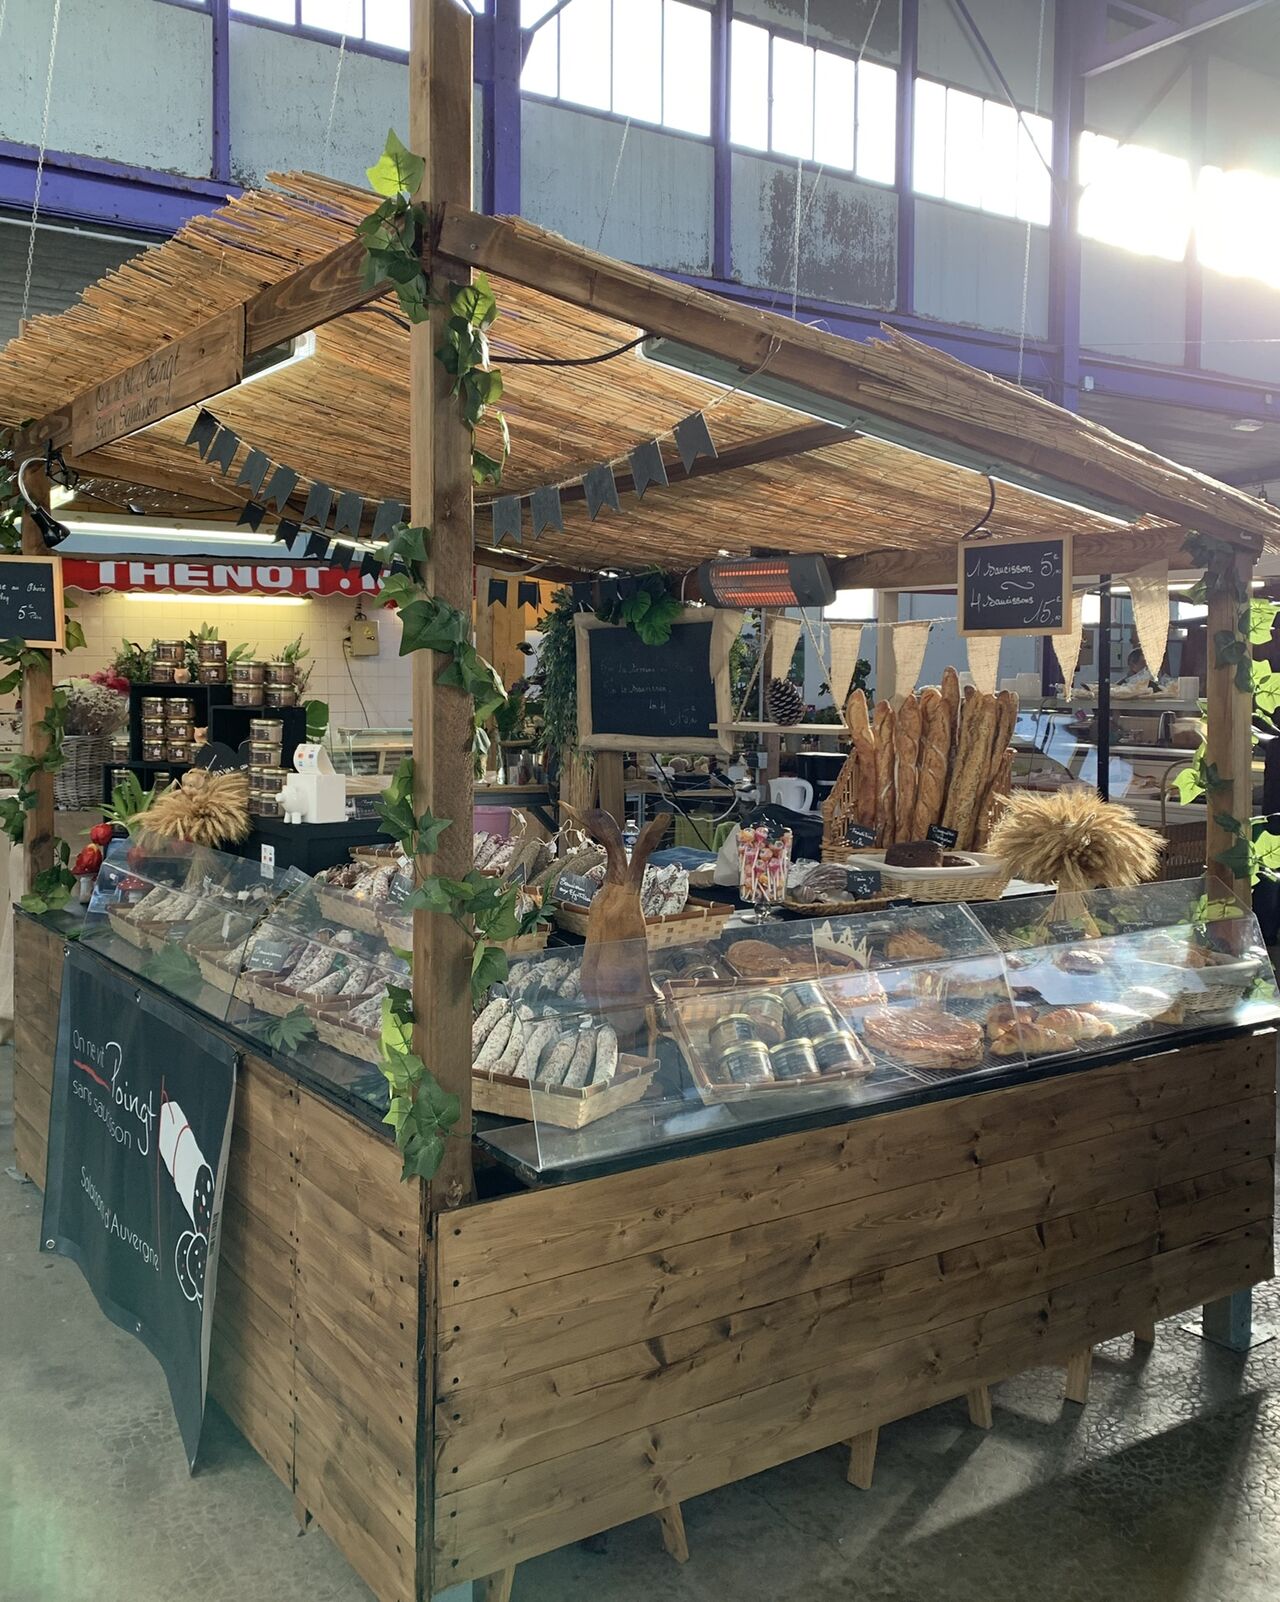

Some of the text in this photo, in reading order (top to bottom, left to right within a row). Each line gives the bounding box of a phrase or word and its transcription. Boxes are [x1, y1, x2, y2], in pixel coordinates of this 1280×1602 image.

[72, 1028, 85, 1054] On
[105, 1040, 157, 1156] Poingt
[72, 1079, 93, 1106] sans
